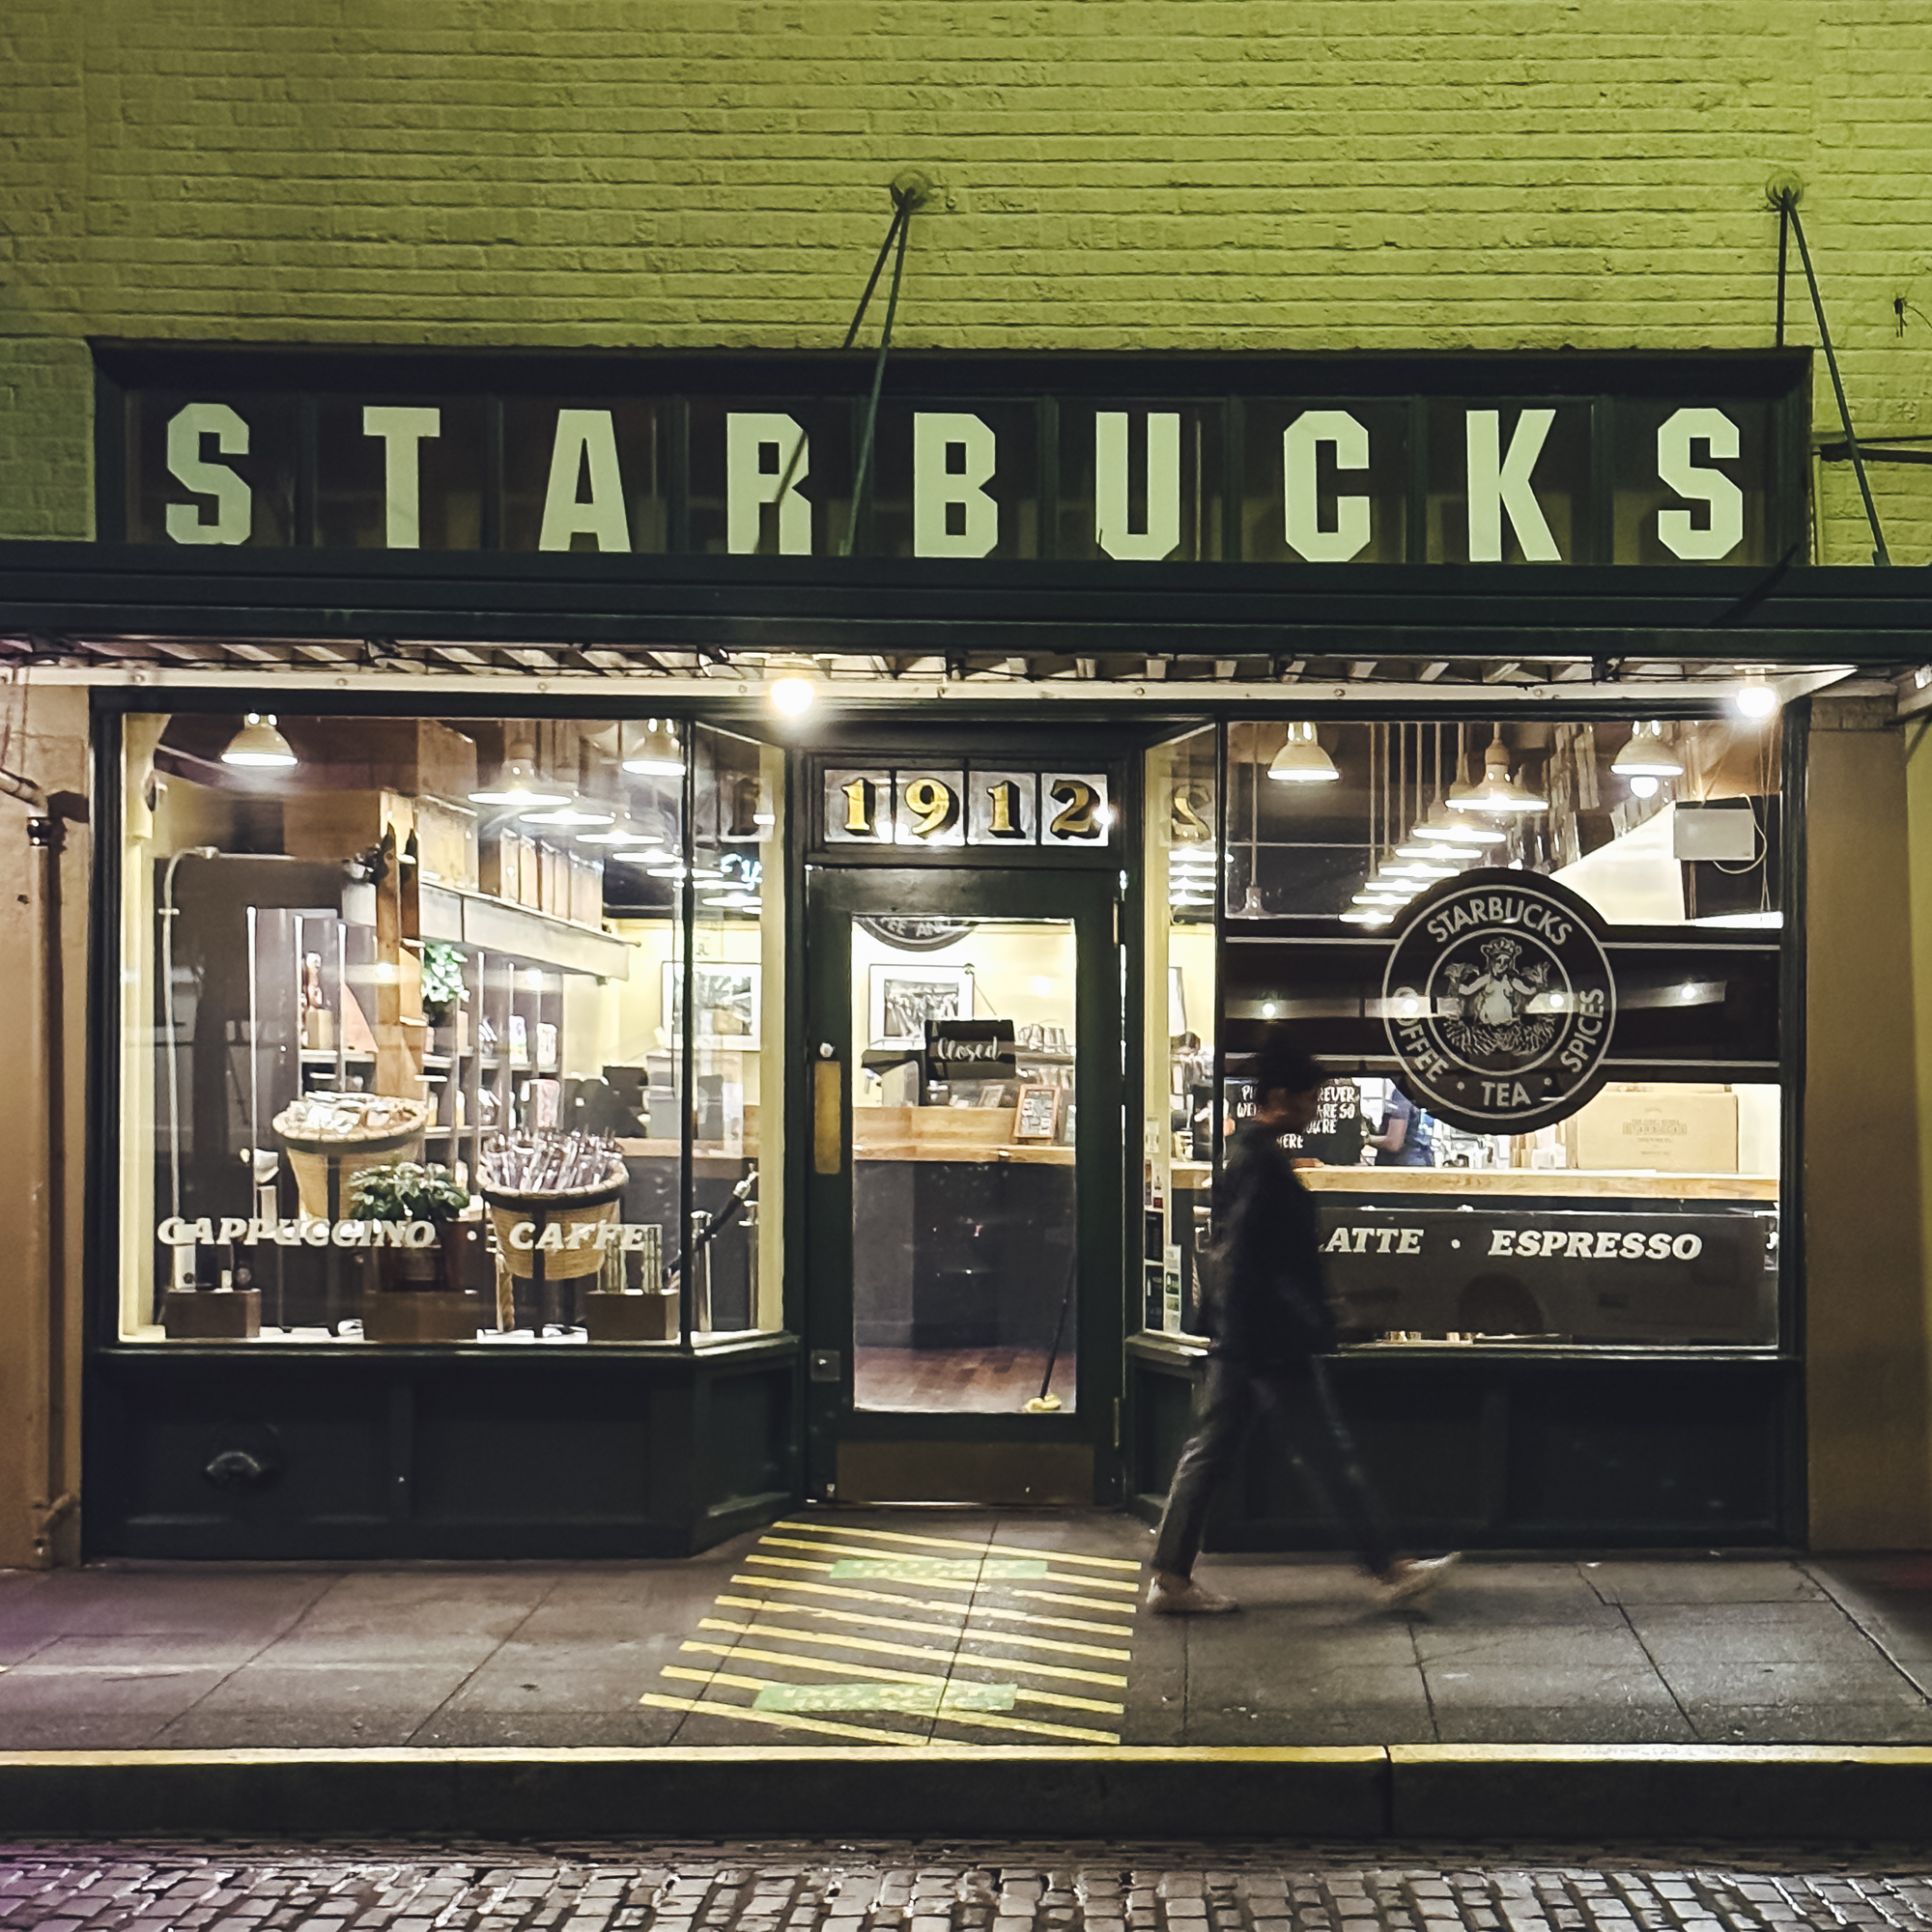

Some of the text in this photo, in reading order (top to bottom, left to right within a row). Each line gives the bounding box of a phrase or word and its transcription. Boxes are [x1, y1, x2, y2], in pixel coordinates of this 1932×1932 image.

[165, 403, 1744, 563] STARBUCKS
[840, 777, 1101, 839] 1912
[1427, 896, 1573, 945] STARBUCKS
[936, 1035, 1002, 1063] Closed
[1481, 1081, 1532, 1108] TEA
[1560, 987, 1605, 1073] SPICES
[1339, 1102, 1356, 1120] SO
[156, 1215, 653, 1252] CAPPUCCINO CAFFE
[1317, 1227, 1703, 1261] ATTE ESPRESSO
